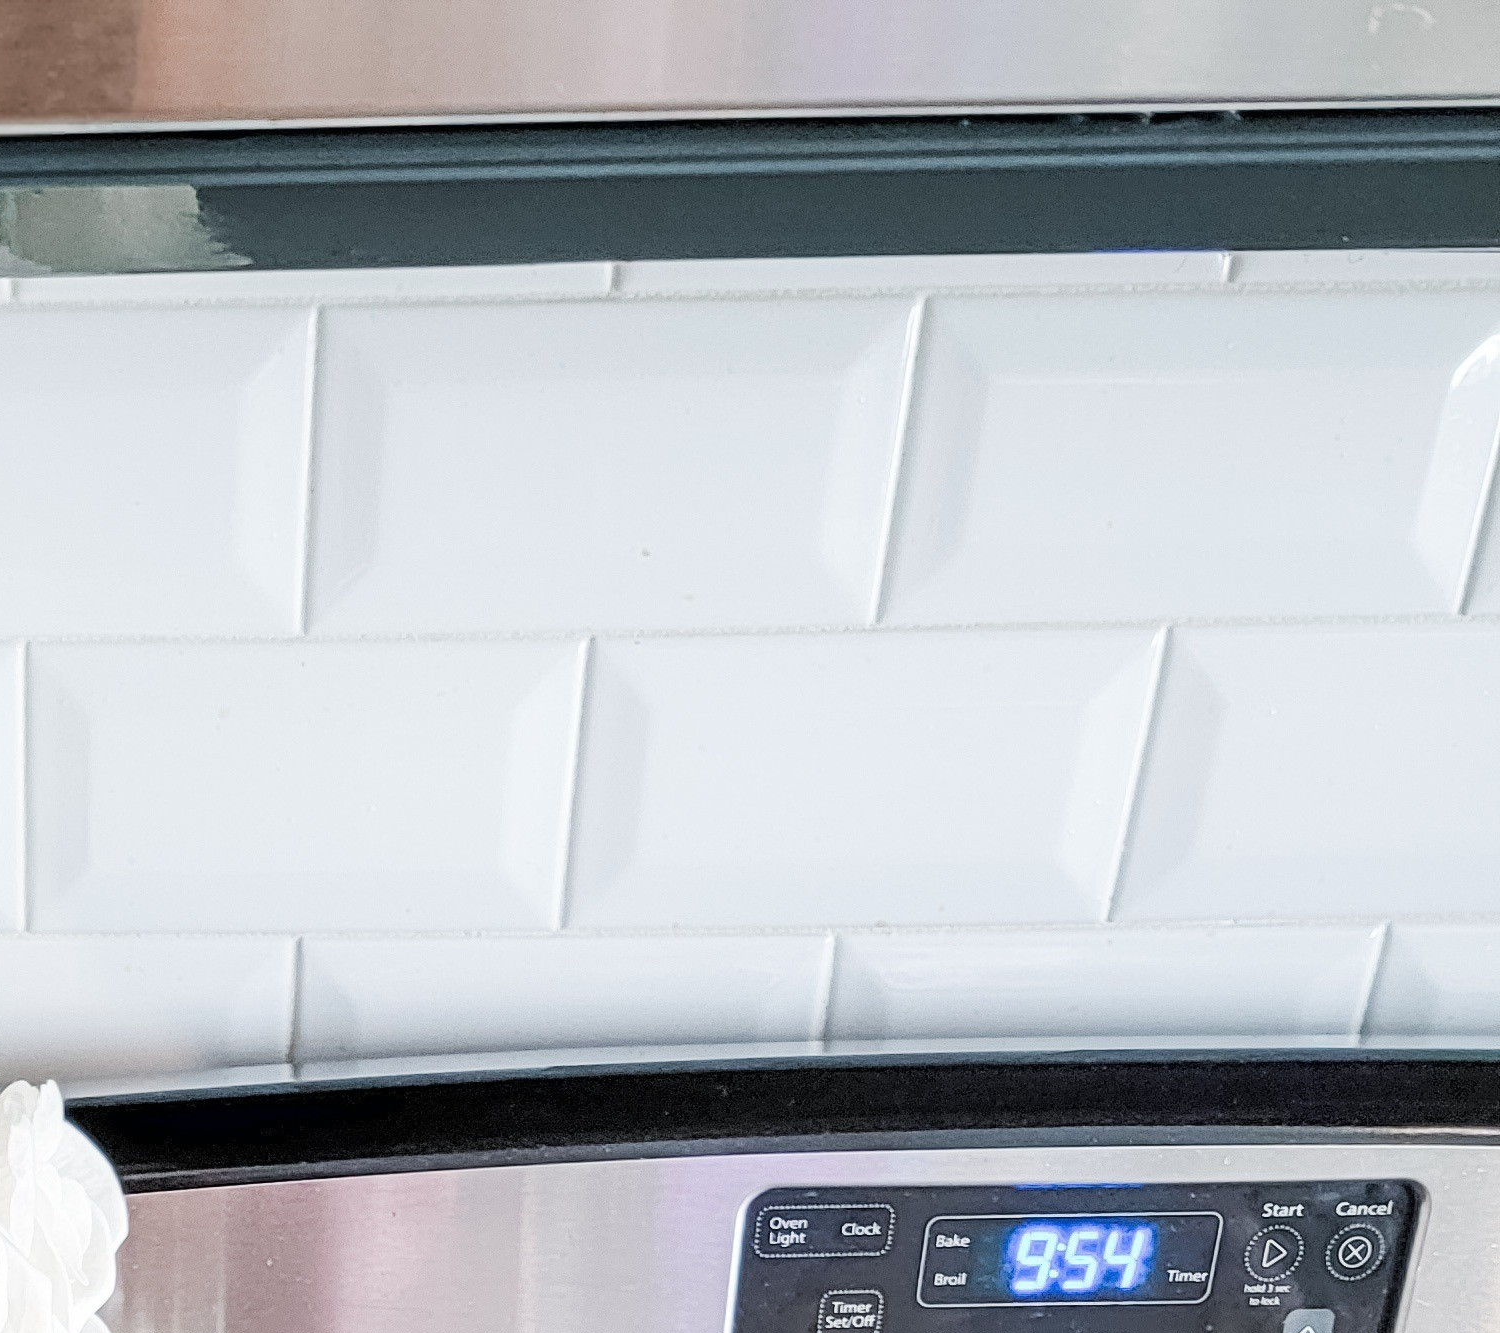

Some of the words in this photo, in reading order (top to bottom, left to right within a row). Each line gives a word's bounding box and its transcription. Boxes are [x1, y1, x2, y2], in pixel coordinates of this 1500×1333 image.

[1261, 1203, 1305, 1218] Start
[1335, 1200, 1394, 1217] Cancel
[769, 1217, 809, 1230] Oven
[841, 1222, 882, 1236] Clock
[769, 1231, 807, 1248] Light
[935, 1234, 971, 1248] Bake
[1012, 1230, 1150, 1291] 9:54
[933, 1272, 968, 1286] Broil
[1167, 1269, 1208, 1283] Timer
[831, 1301, 873, 1314] Timer
[825, 1314, 876, 1329] Set/Off
